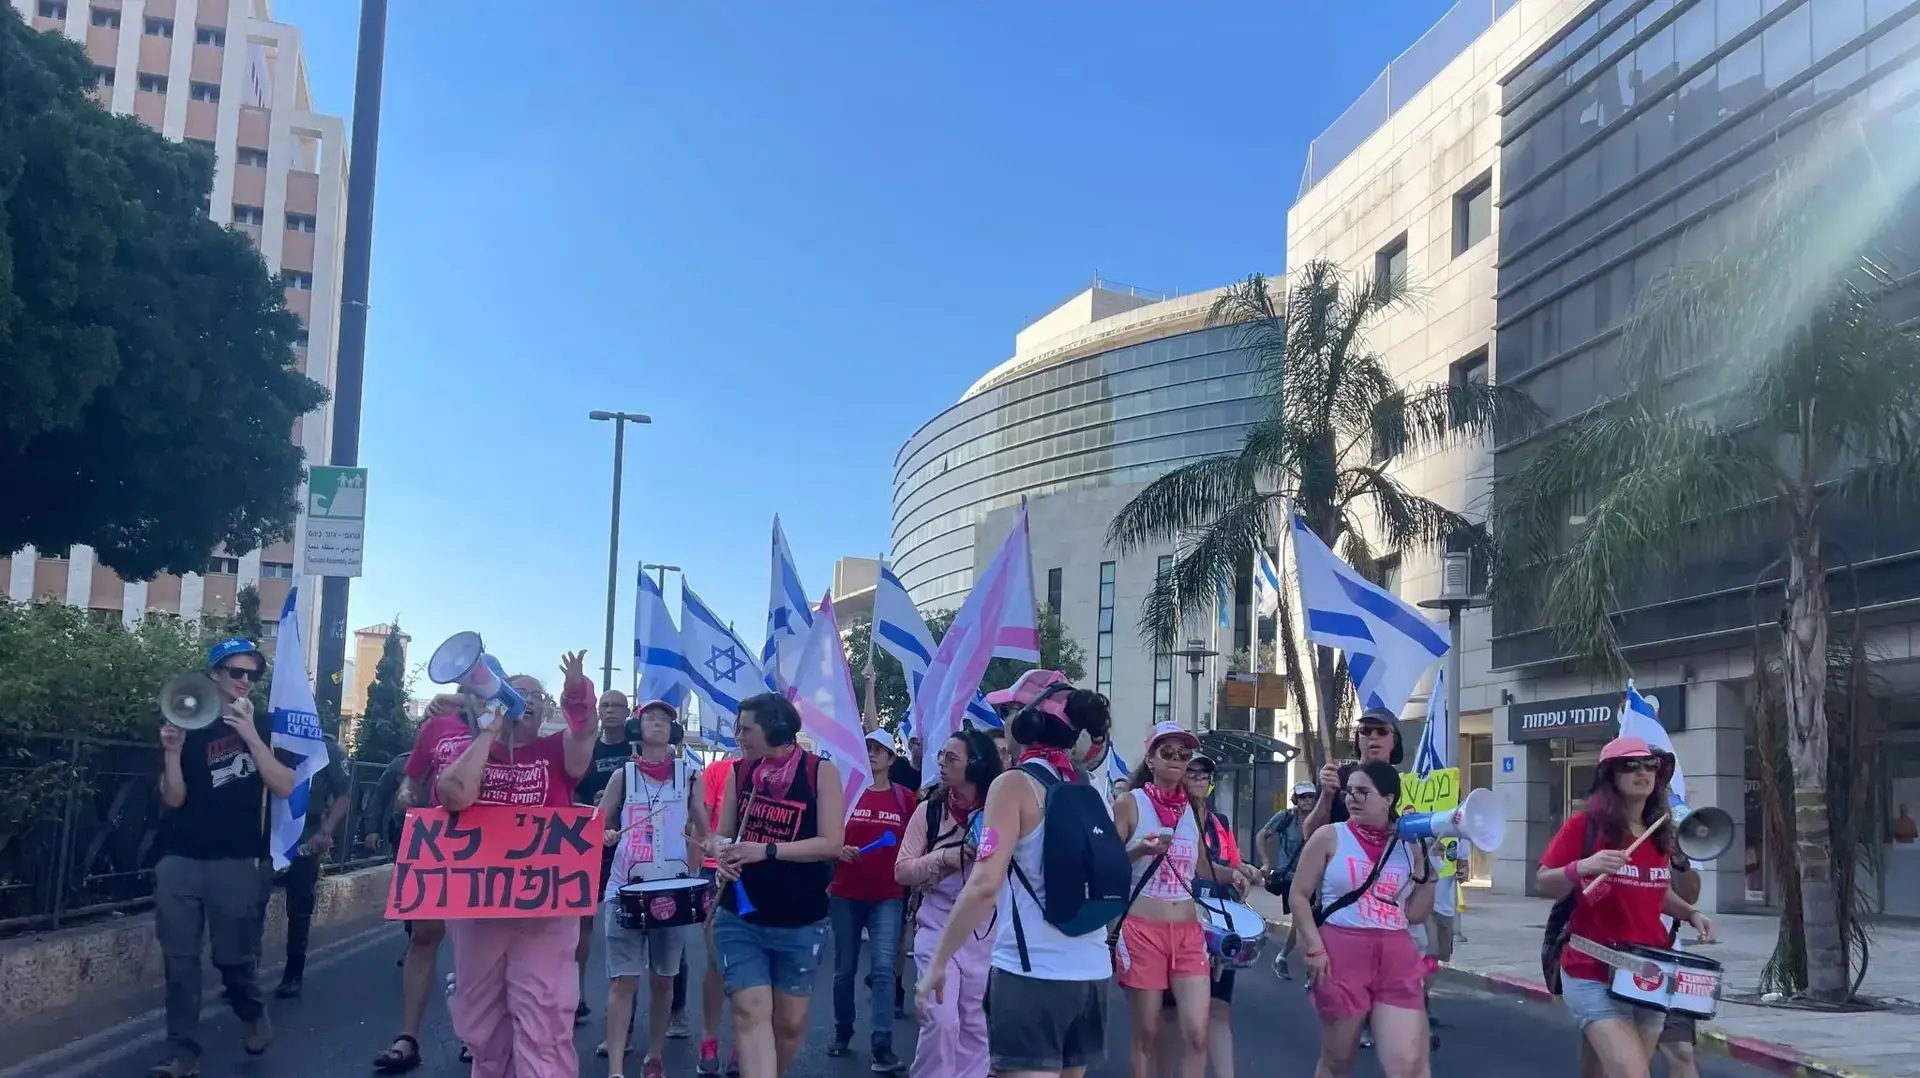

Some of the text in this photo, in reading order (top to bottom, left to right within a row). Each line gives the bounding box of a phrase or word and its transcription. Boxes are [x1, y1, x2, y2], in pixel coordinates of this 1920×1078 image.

[1522, 706, 1612, 729] מזרחי טפחות
[878, 810, 901, 822] מאבק
[406, 810, 595, 862] אני לא
[1649, 867, 1671, 881] אבק
[393, 862, 592, 914] מפחדת!
